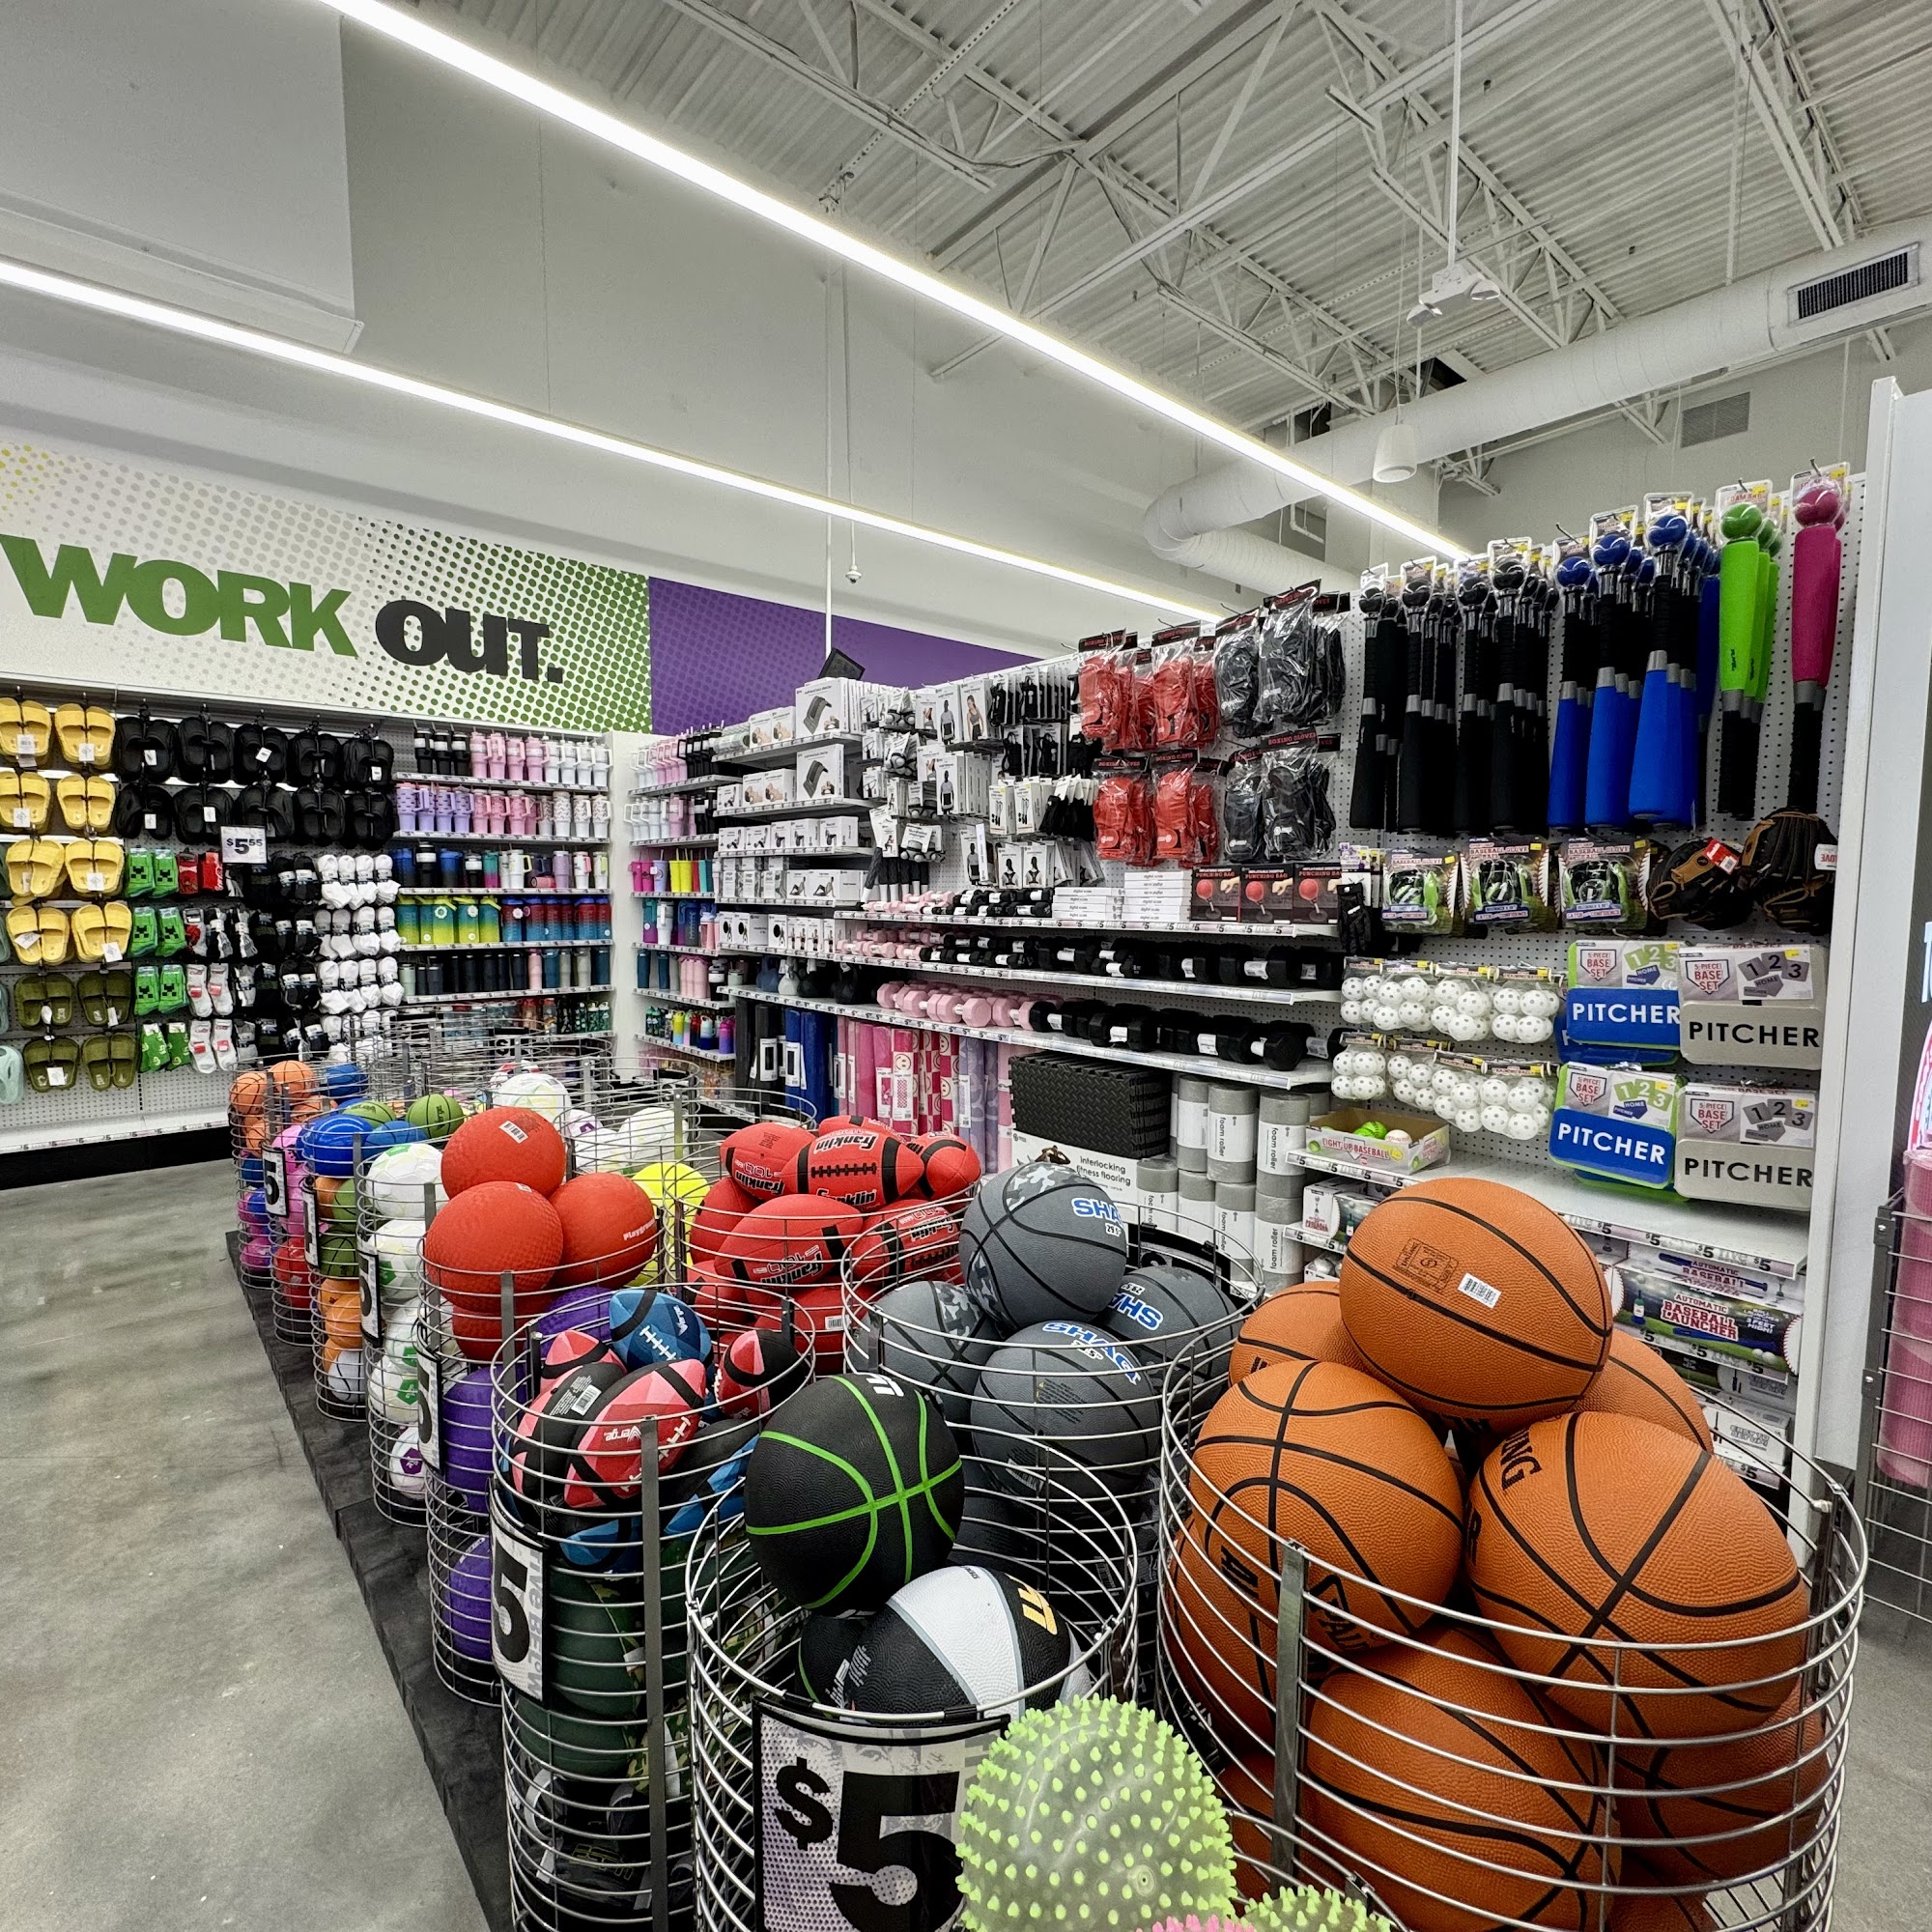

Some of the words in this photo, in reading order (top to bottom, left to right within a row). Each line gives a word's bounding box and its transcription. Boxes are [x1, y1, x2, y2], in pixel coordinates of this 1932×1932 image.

[0, 534, 358, 658] WORK
[375, 600, 563, 684] OUT.
[1631, 952, 1641, 966] 1
[1650, 946, 1660, 960] 2
[1586, 958, 1611, 968] BASE
[1664, 955, 1676, 969] 3
[1768, 954, 1781, 969] 2
[1590, 968, 1606, 979] SET
[1637, 967, 1658, 976] HOME
[1694, 970, 1722, 980] BASE
[1747, 962, 1759, 977] 1
[1788, 963, 1802, 979] 3
[1699, 980, 1719, 991] SET
[1755, 976, 1778, 987] HOME
[1572, 1003, 1681, 1024] PITCHER
[1690, 1021, 1820, 1048] PITCHER
[1576, 1083, 1599, 1094] BASE
[1621, 1085, 1630, 1098] 1
[1638, 1082, 1649, 1096] 2
[1578, 1092, 1594, 1103] SET
[1654, 1093, 1665, 1107] 3
[1698, 1109, 1725, 1120] BASE
[1751, 1107, 1763, 1121] 1
[1773, 1102, 1785, 1116] 2
[1702, 1120, 1721, 1129] SET
[1792, 1112, 1804, 1126] 3
[1757, 1122, 1781, 1131] HOME
[815, 1131, 878, 1154] Franklin
[1557, 1122, 1665, 1165] PITCHER
[1353, 1145, 1389, 1159] BASEBALL
[1076, 1165, 1099, 1179] fitness
[1100, 1169, 1131, 1186] flooring
[1685, 1157, 1812, 1187] PITCHER
[264, 1158, 280, 1206] 5
[735, 1170, 785, 1196] Franklin
[816, 1188, 878, 1207] Fnklin
[1071, 1197, 1124, 1228] SHA
[1597, 1222, 1611, 1235] $5
[1645, 1233, 1661, 1246] $5
[1697, 1244, 1714, 1258] $5
[1692, 1261, 1739, 1276] AUTOMATIC
[1753, 1257, 1772, 1272] $5
[1675, 1293, 1727, 1314] AUTOMATIC
[1108, 1293, 1163, 1331] SHA
[1664, 1300, 1737, 1329] BASEBALL
[1662, 1310, 1738, 1340] LAUNCHER
[1752, 1320, 1776, 1329] FEET
[1042, 1321, 1142, 1386] SHAQ
[603, 1424, 641, 1442] Verge
[1740, 1463, 1758, 1480] $5
[494, 1536, 530, 1663] 5
[775, 1757, 966, 1932] $5
